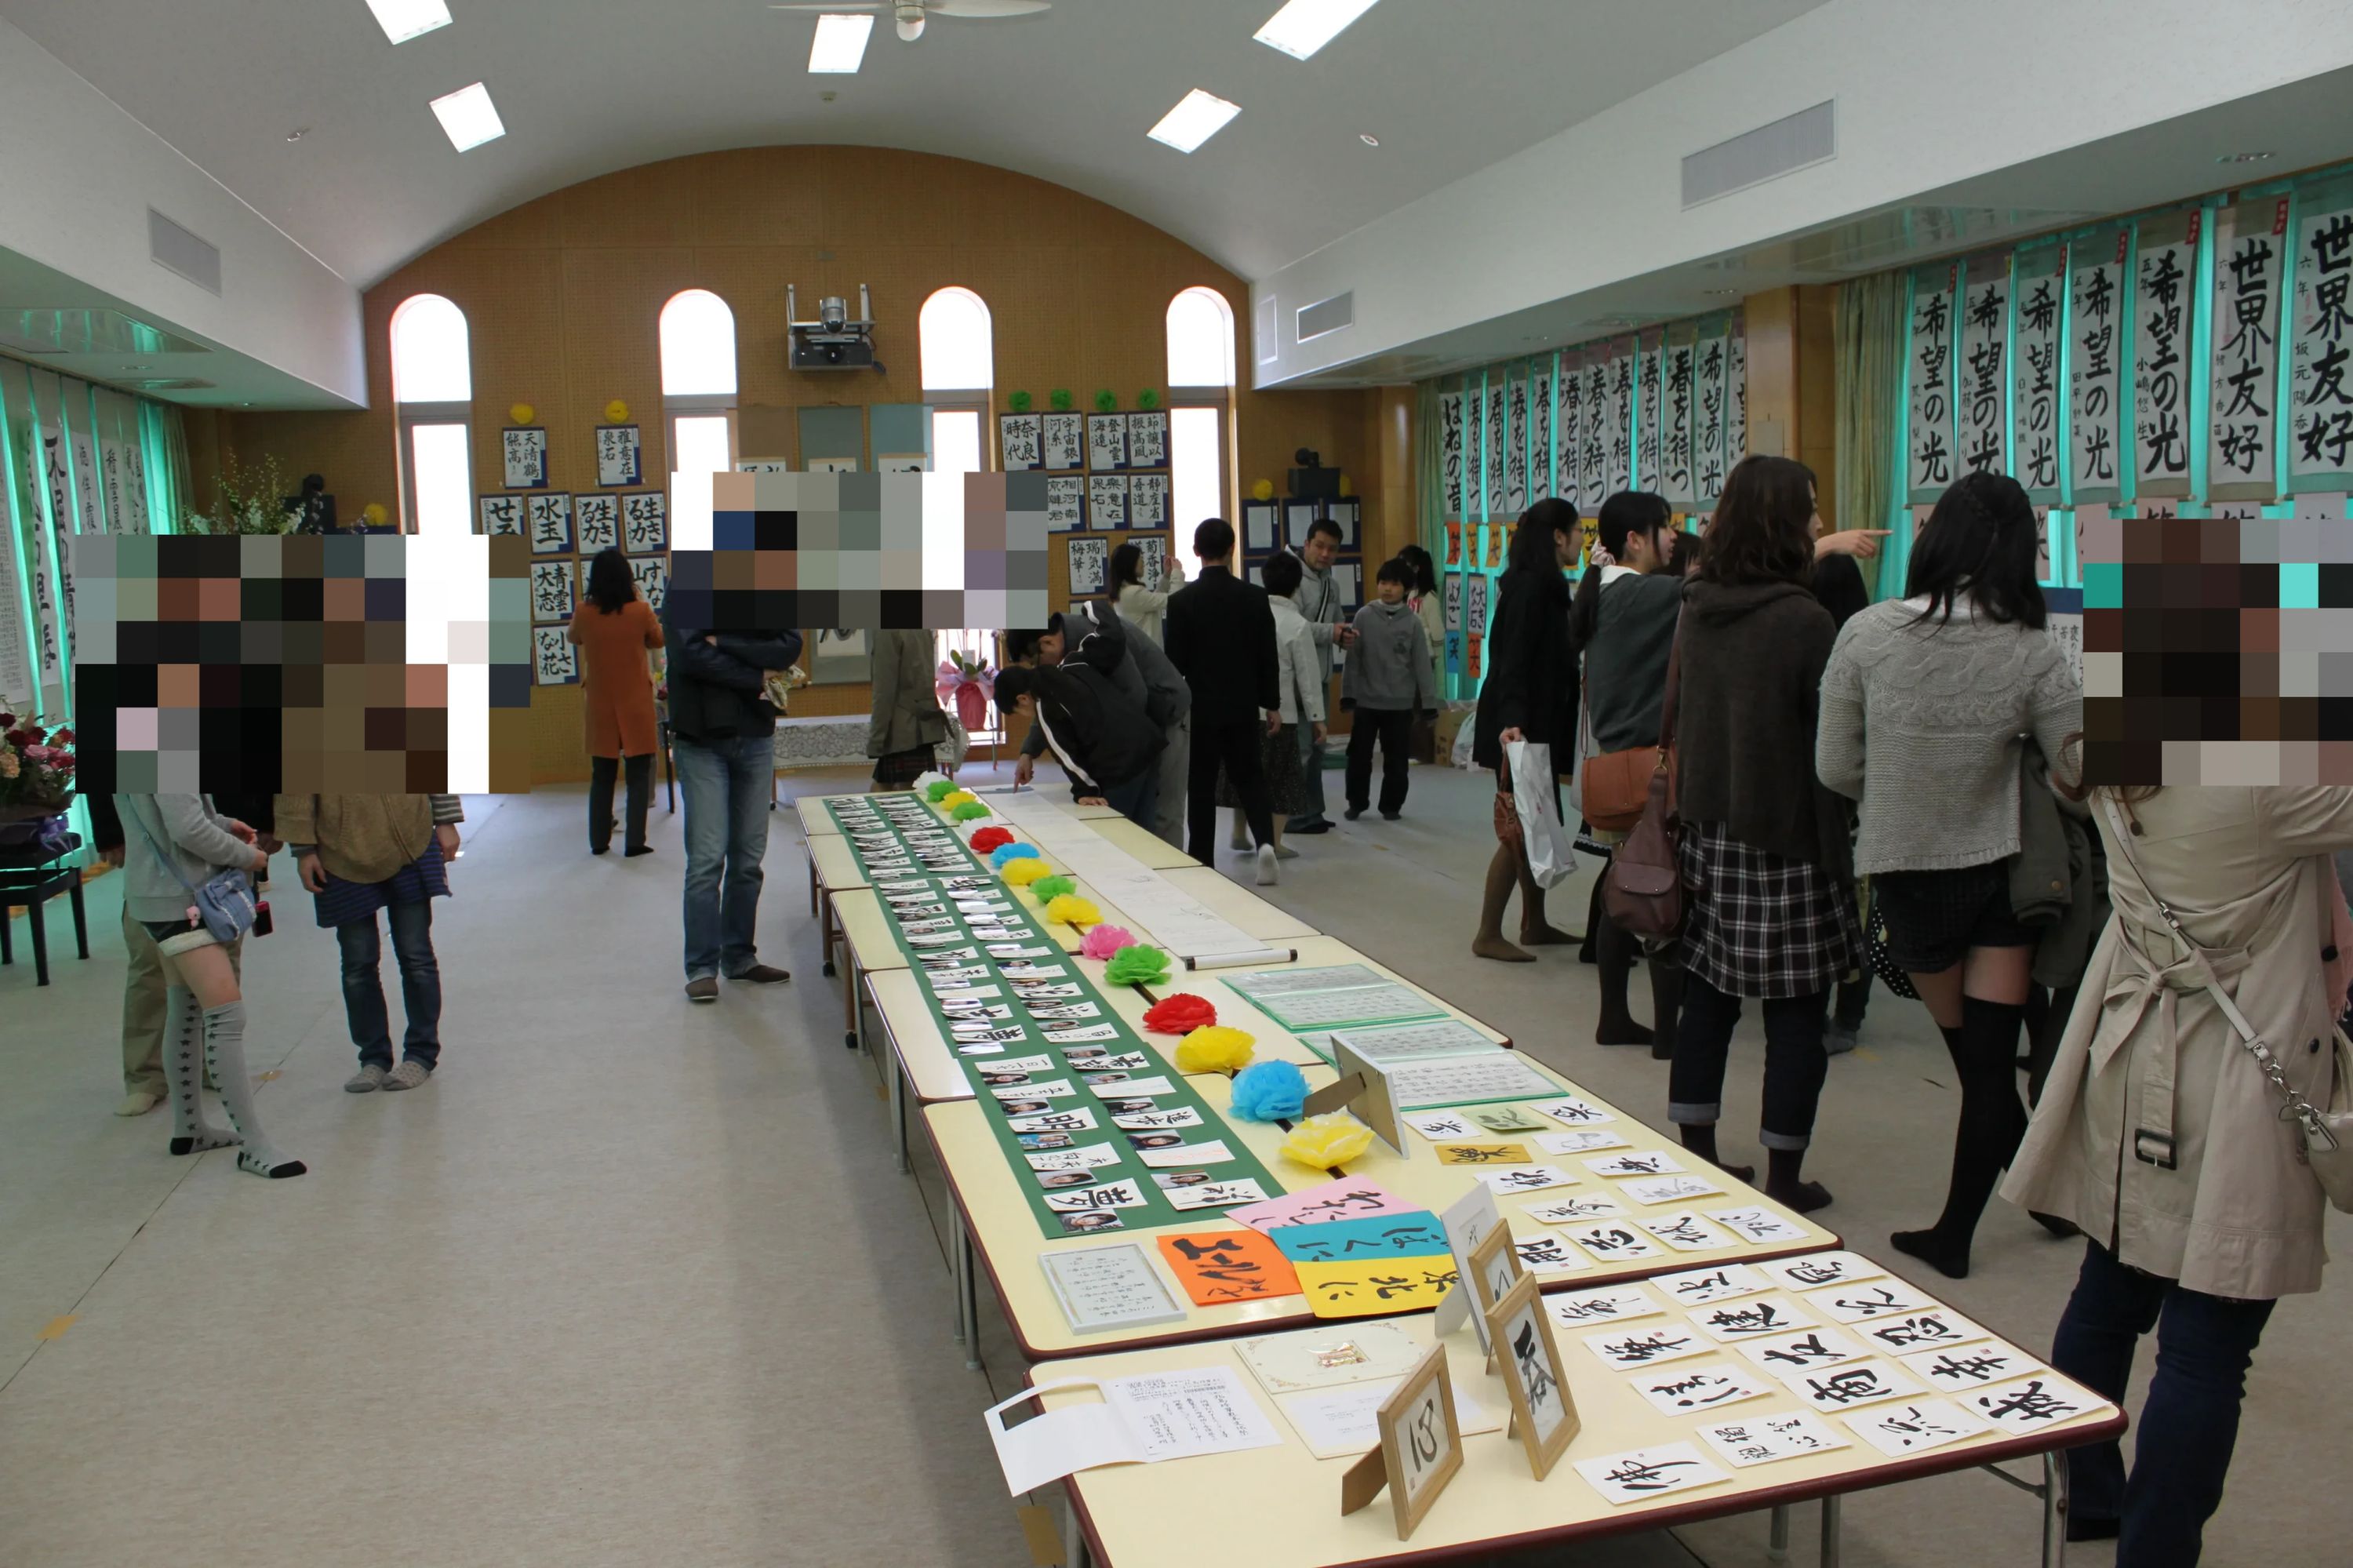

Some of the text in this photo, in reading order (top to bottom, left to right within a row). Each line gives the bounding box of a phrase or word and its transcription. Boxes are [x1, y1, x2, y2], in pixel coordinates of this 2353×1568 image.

[2072, 275, 2083, 309] 五年
[2139, 258, 2153, 293] 五年
[2217, 258, 2229, 293] 六年
[2296, 255, 2313, 298] 六年
[2144, 249, 2187, 474] 希望の光
[2220, 238, 2273, 474] 世界友好
[2298, 216, 2353, 467] 世界友好
[1920, 293, 1949, 486] 希望の光
[2023, 279, 2057, 489] 希望の光
[2082, 267, 2114, 479] 希望の光
[2293, 342, 2311, 431] 坂元陽香
[1667, 350, 1692, 492] 春を待つ
[1702, 340, 1723, 499] 希望の光
[2135, 358, 2151, 441] 小嶋悠生
[603, 430, 616, 461] 泉石
[1006, 418, 1024, 461] 時代
[1020, 418, 1037, 461] 奈良
[1062, 417, 1079, 460] 宇宙銀
[1107, 417, 1122, 461] 登山雲
[1562, 373, 1583, 508] 春を待つ
[1586, 365, 1606, 504] 春を待つ
[1613, 359, 1632, 492] 春を待つ
[1642, 354, 1659, 493] 春を待つ
[523, 432, 540, 478] 天清鶴
[617, 429, 634, 476] 雅意在
[1444, 395, 1462, 514] はねの音
[1489, 389, 1503, 511] 春を待つ
[1509, 383, 1527, 511] 春を待つ
[535, 497, 564, 544] 水玉
[594, 499, 614, 544] 生き
[642, 497, 662, 543] 生き
[1071, 542, 1086, 573] 梅華
[536, 566, 556, 613] 大志
[551, 563, 570, 613] 青雲
[644, 561, 664, 607] すな
[540, 631, 561, 677] な花
[552, 630, 573, 675] 小さ
[1026, 1114, 1088, 1131] 明
[1119, 1110, 1194, 1126] 進歩
[1050, 1186, 1135, 1209] 夢
[1575, 1227, 1650, 1251] 志
[1646, 1214, 1713, 1245] 城
[1170, 1236, 1270, 1298] エールを
[1782, 1258, 1854, 1285] 風
[1704, 1300, 1791, 1334] 健
[1834, 1286, 1912, 1317] 光
[1602, 1331, 1693, 1363] 筆
[1760, 1331, 1848, 1367] 友
[1870, 1315, 1965, 1348] 忍
[1804, 1366, 1893, 1405] 商
[1929, 1353, 2013, 1382] 幸
[1647, 1372, 1742, 1409] 清
[1976, 1378, 2081, 1422] 城
[1876, 1404, 1958, 1447] 流
